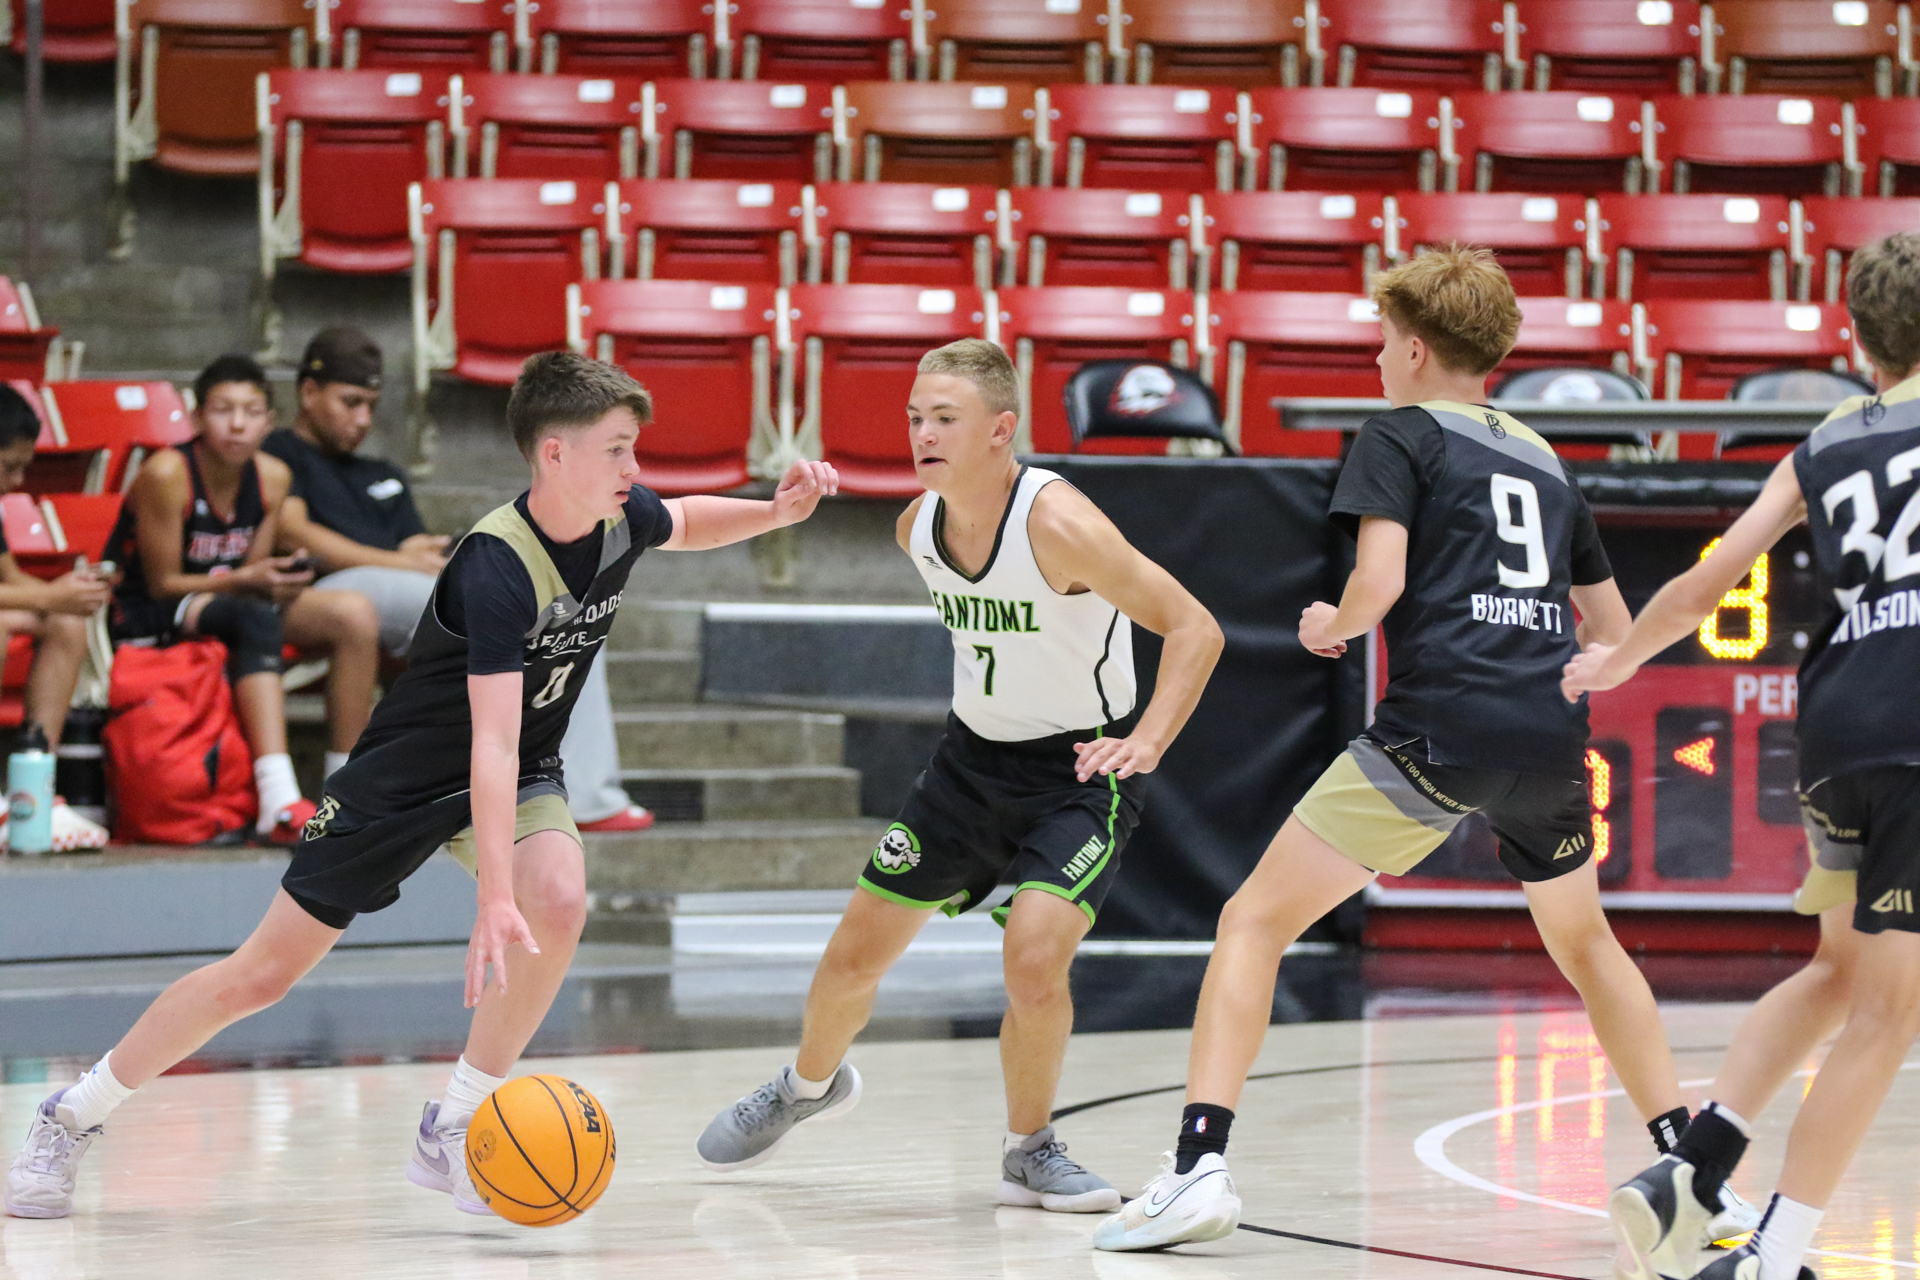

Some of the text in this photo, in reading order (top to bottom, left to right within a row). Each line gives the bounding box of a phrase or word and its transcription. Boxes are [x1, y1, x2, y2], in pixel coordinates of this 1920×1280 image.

[1490, 472, 1551, 589] 9
[932, 589, 1042, 633] FANTOMZ
[1471, 593, 1563, 635] BURNETT
[531, 661, 575, 709] 0
[971, 643, 996, 697] 7
[1405, 760, 1421, 778] TOO
[1418, 775, 1437, 795] HIGH
[1433, 791, 1459, 808] NEVER
[1061, 834, 1107, 882] FANTOMZ
